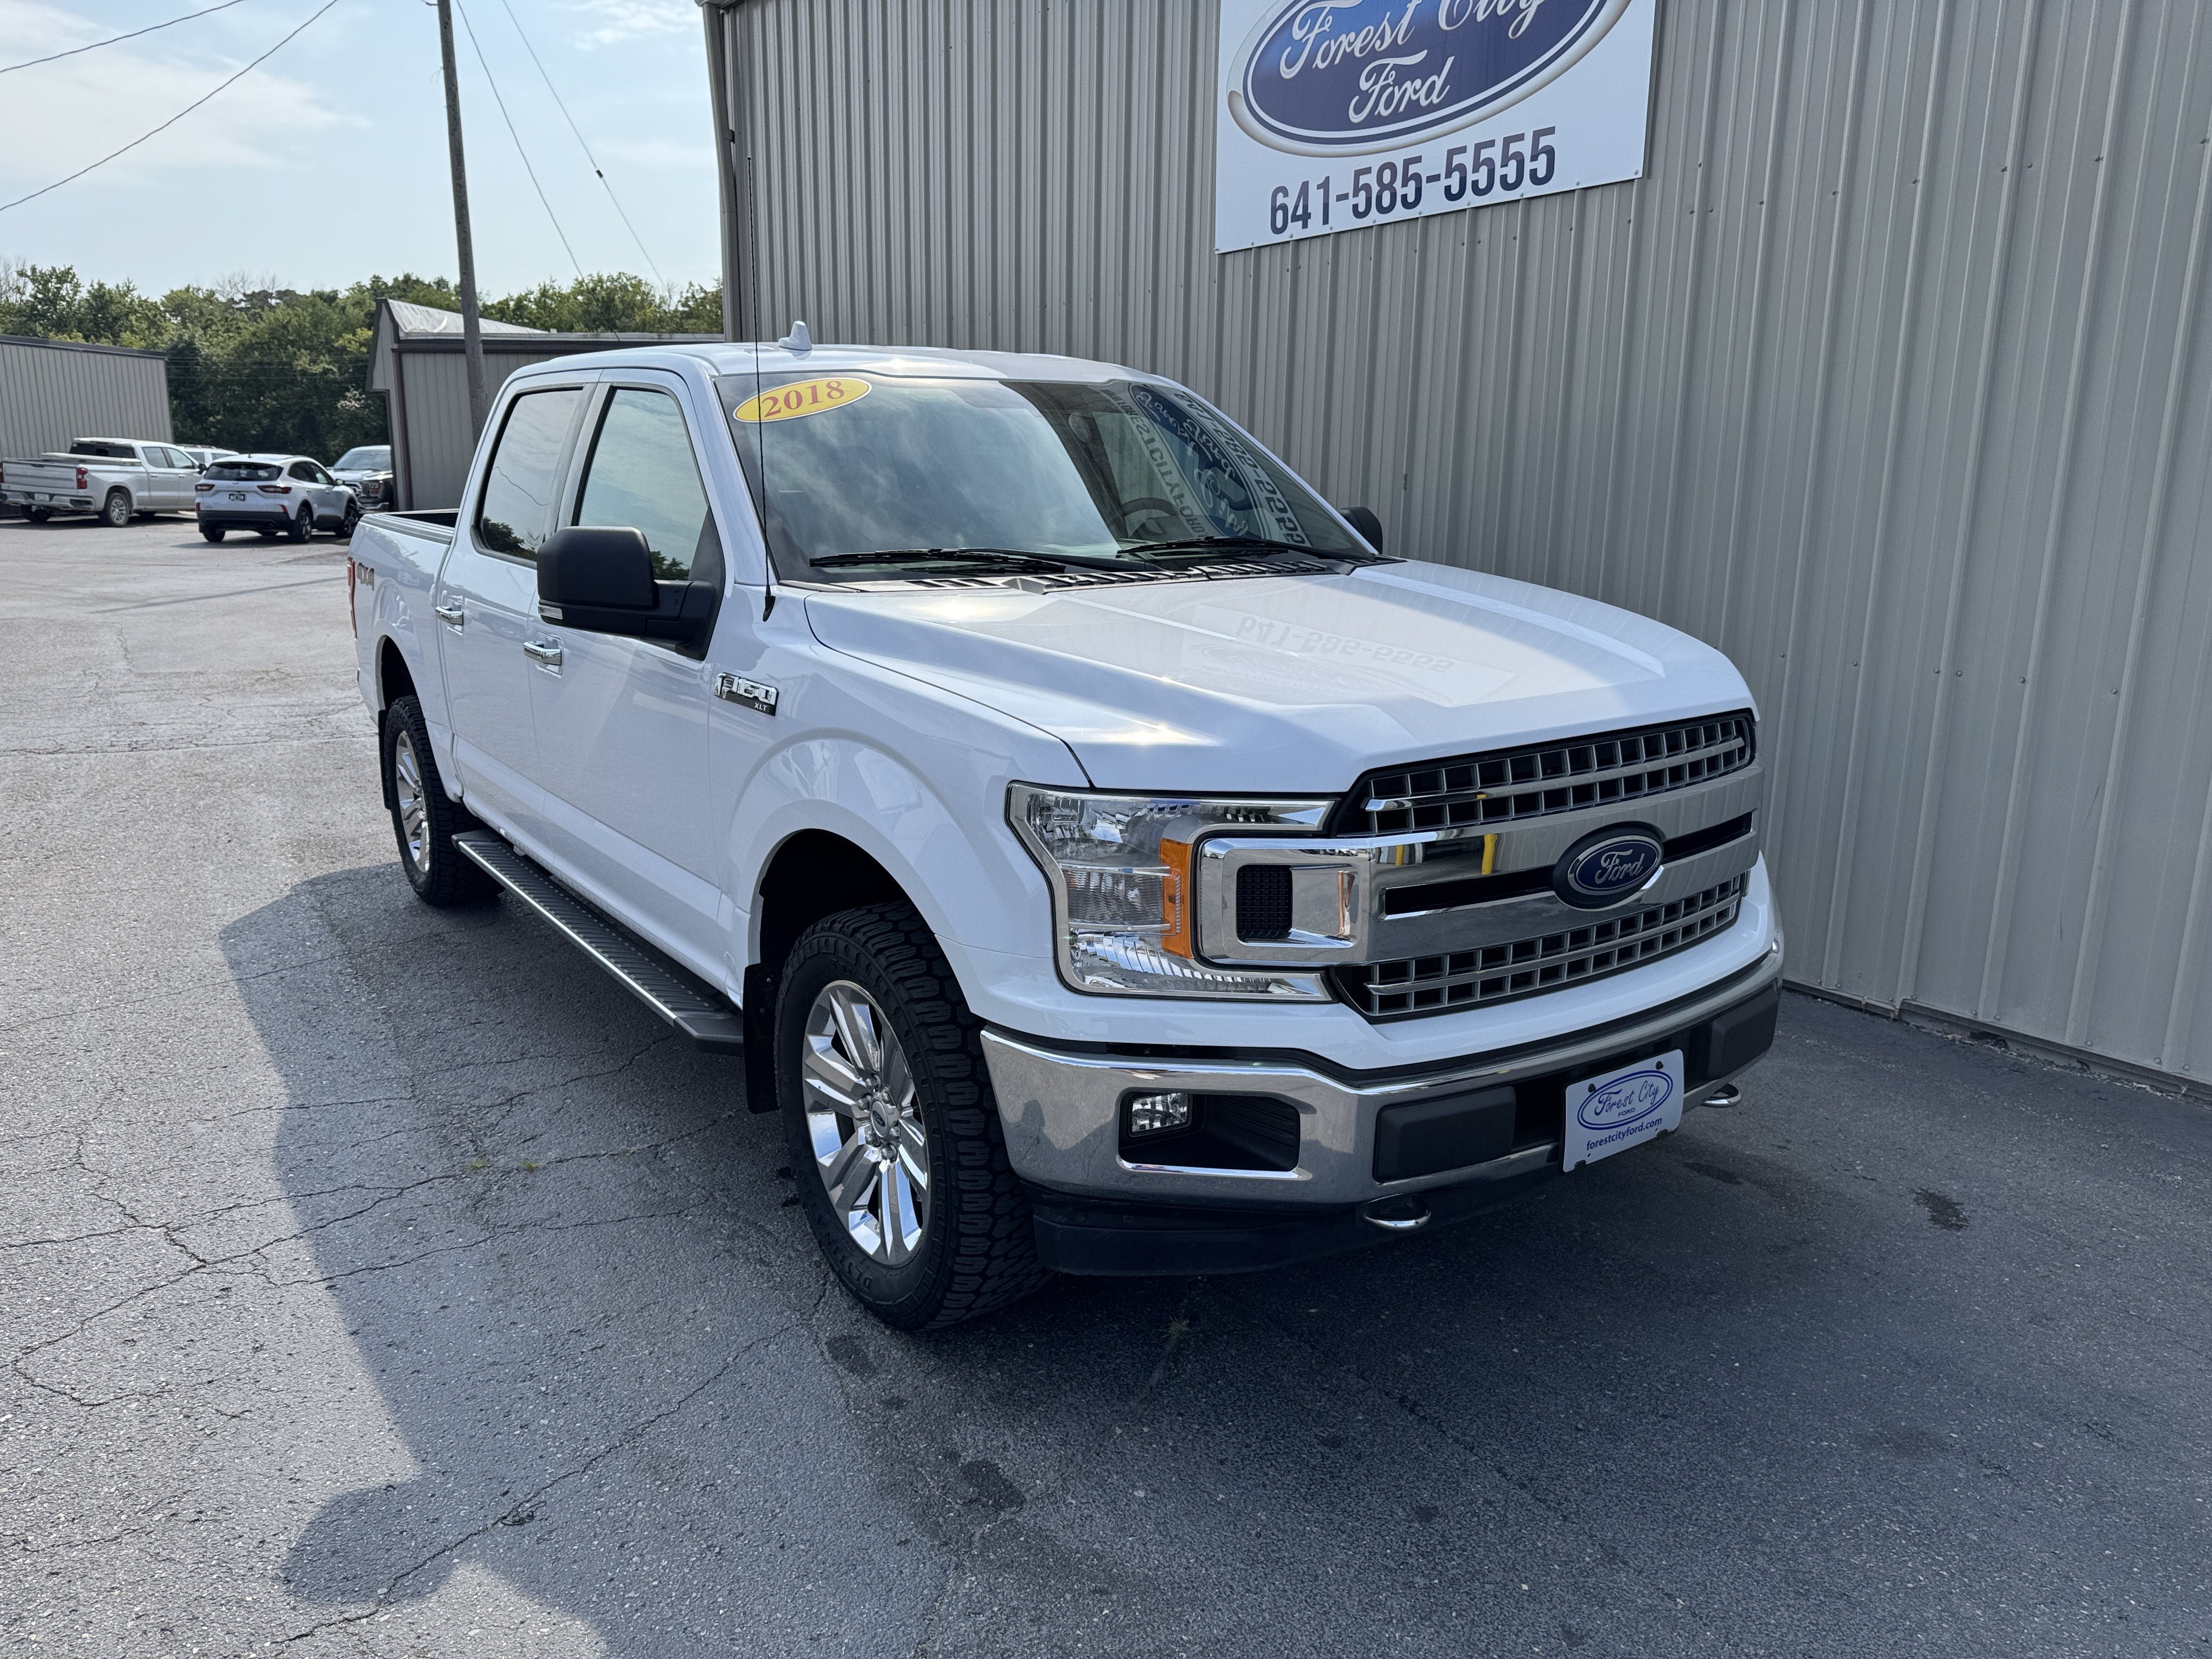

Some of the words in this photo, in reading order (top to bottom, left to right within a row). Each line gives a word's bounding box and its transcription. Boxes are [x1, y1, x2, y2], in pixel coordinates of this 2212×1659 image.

[1279, 0, 1423, 79] Forest
[1348, 49, 1455, 123] Ford
[1271, 126, 1556, 235] 641-585-5555
[761, 380, 845, 418] 2018
[754, 702, 768, 712] XLT
[1595, 849, 1645, 884] Ford
[1594, 1088, 1634, 1116] Forest
[1638, 1080, 1660, 1105] City
[1618, 1107, 1635, 1118] FORD
[1587, 1118, 1662, 1150] forestcityford.com
